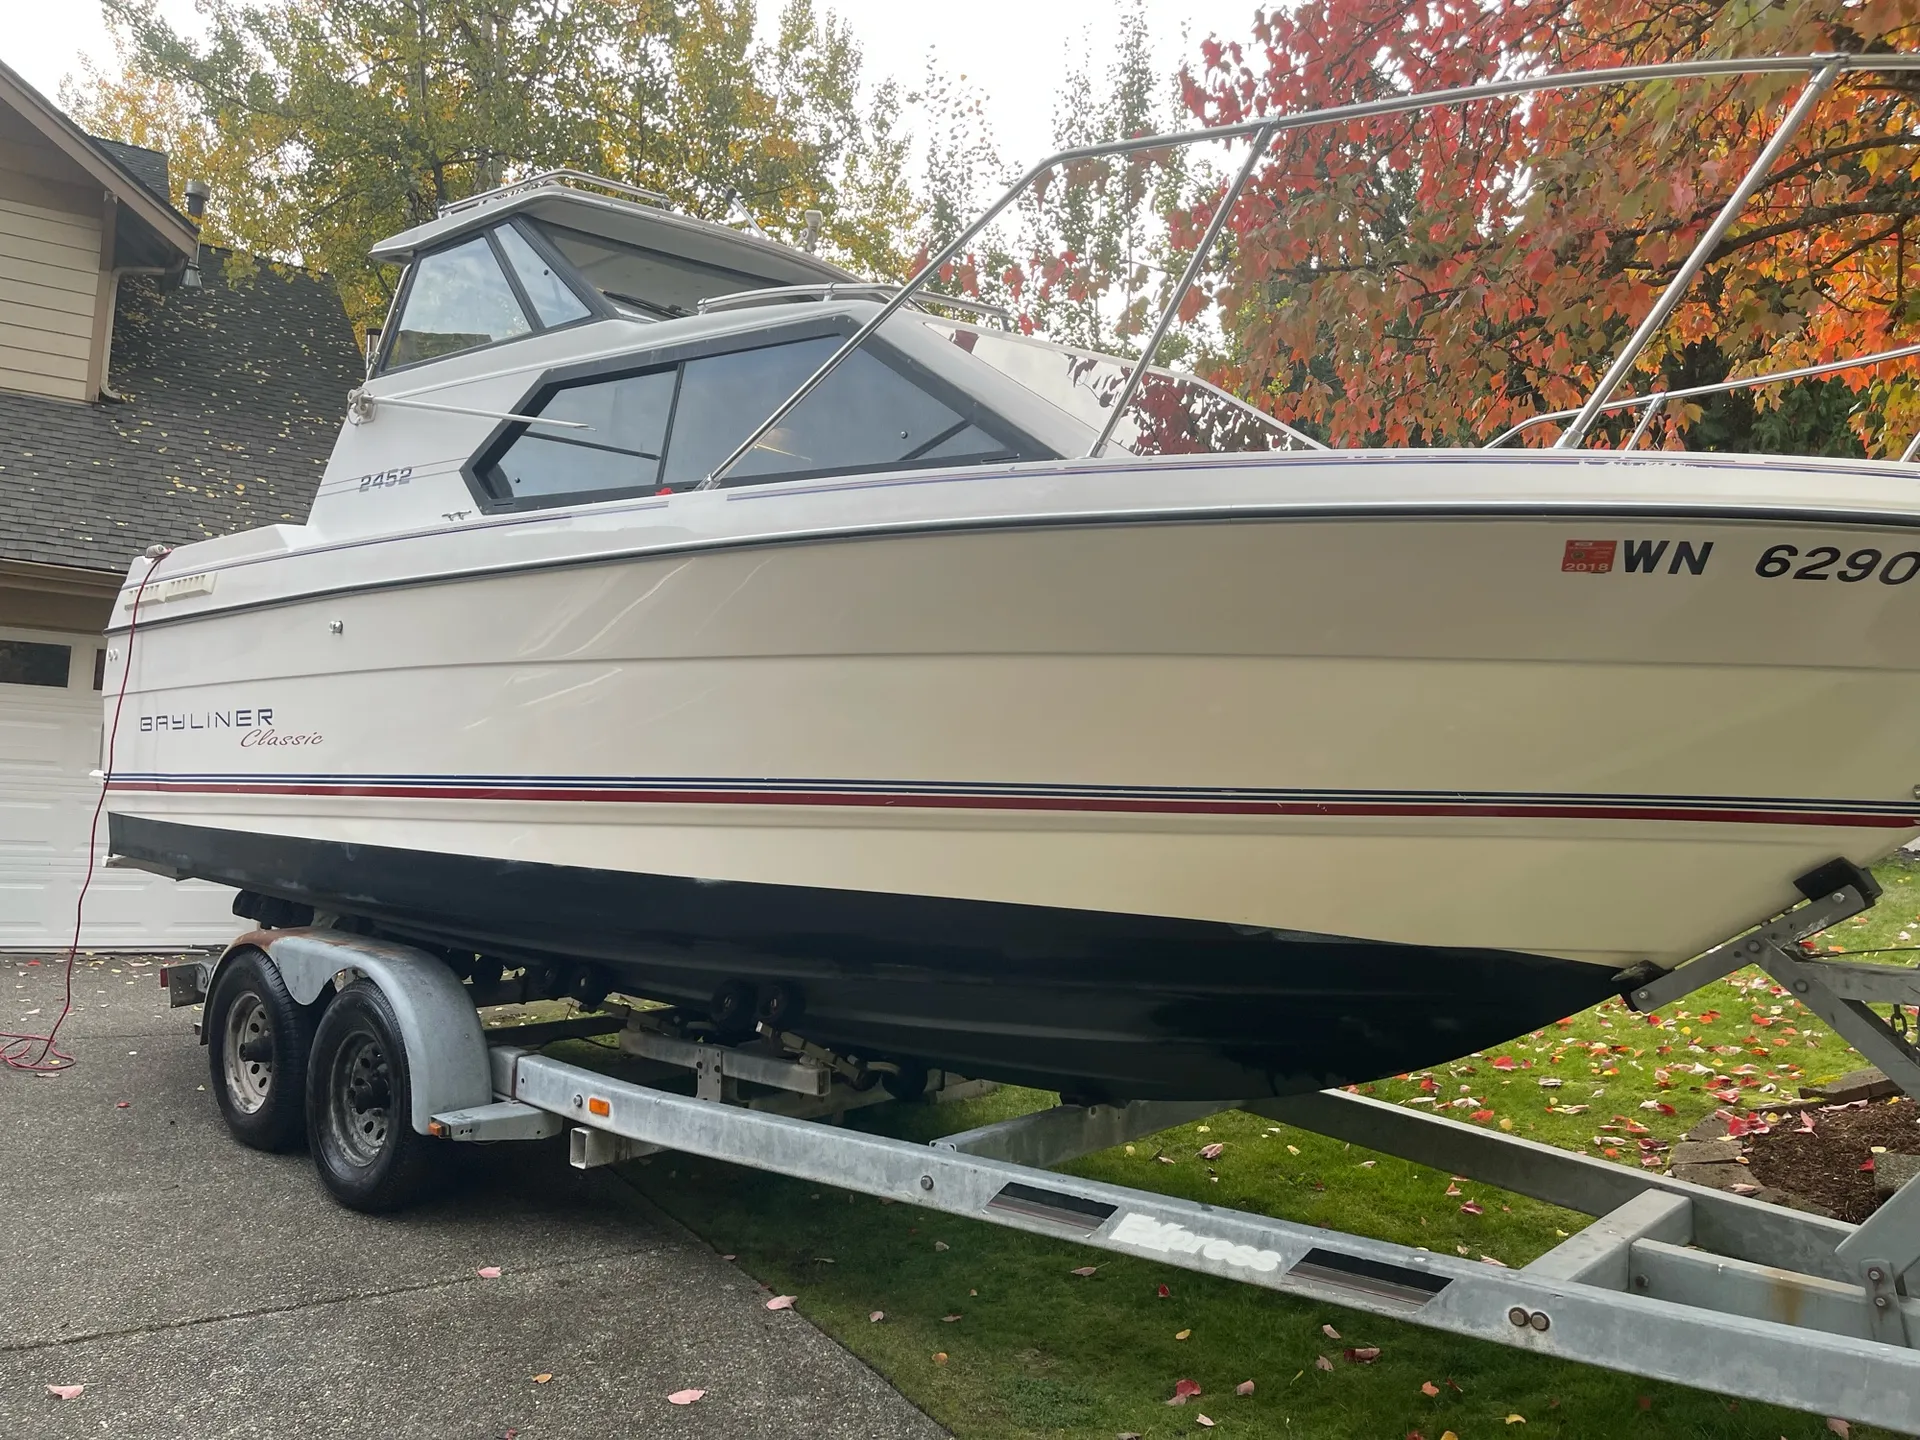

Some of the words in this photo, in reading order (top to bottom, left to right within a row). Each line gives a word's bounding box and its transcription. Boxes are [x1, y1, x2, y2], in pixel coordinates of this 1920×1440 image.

[359, 466, 412, 492] 2452
[1564, 563, 1609, 571] 2018
[1623, 540, 1714, 575] WN
[1755, 544, 1920, 585] 6290
[140, 708, 273, 731] BAYLINER
[240, 728, 324, 747] Classic
